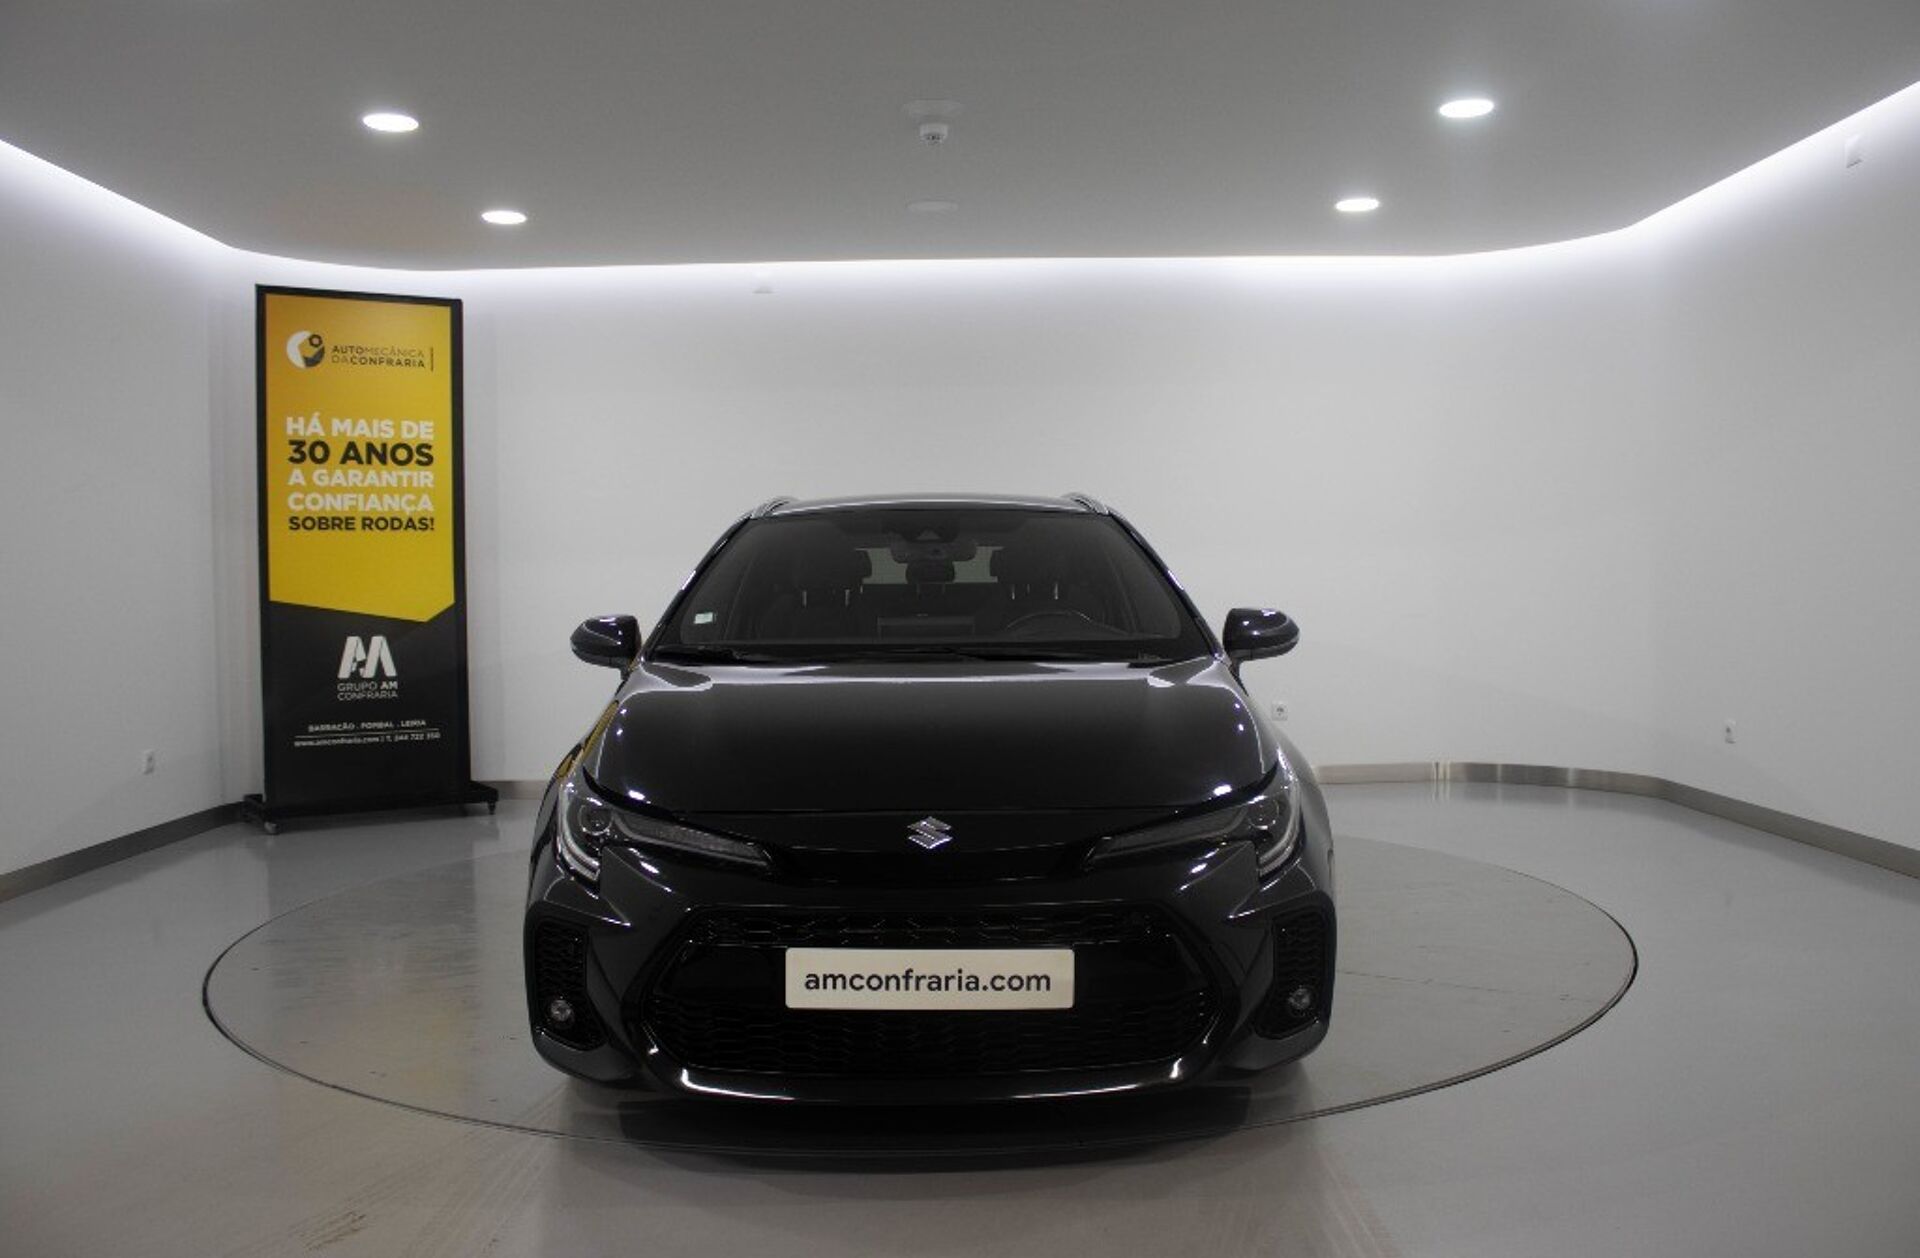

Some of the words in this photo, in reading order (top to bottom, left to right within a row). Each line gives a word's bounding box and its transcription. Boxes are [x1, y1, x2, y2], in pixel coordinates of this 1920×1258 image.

[286, 412, 325, 436] HÁ
[331, 418, 394, 439] MAIS
[400, 420, 434, 440] DE
[287, 439, 331, 465] 30
[340, 442, 434, 467] ANOS
[288, 469, 306, 486] A
[312, 469, 434, 488] GARANTIR
[287, 491, 434, 515] CONFIANÇA
[288, 516, 356, 531] SOBRE
[361, 516, 435, 531] RODAS!
[337, 681, 377, 692] GRUPO
[380, 680, 398, 690] AM
[337, 690, 398, 701] CONFRARIA
[804, 968, 1051, 992] amconfraria.com
